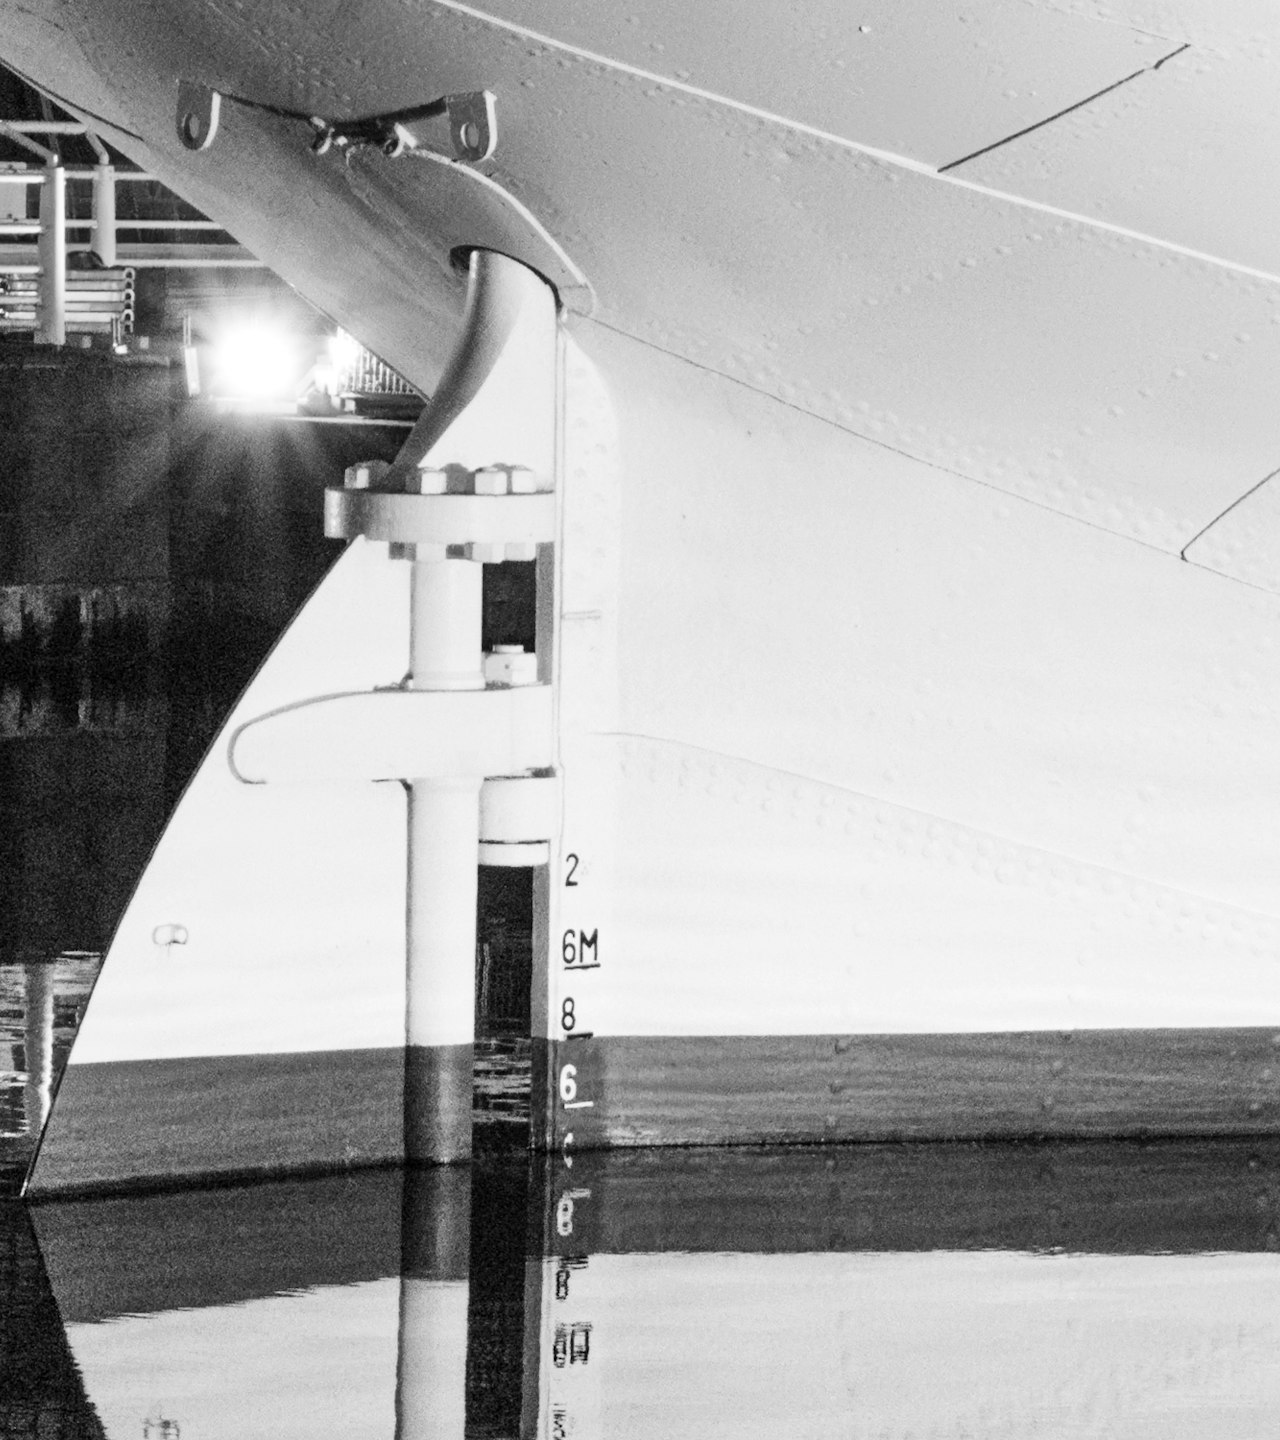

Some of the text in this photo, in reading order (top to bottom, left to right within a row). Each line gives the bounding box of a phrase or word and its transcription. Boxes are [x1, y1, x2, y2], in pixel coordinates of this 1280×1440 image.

[565, 852, 579, 887] 2
[562, 928, 599, 965] 6M
[561, 997, 576, 1031] 8
[559, 1063, 577, 1102] 6
